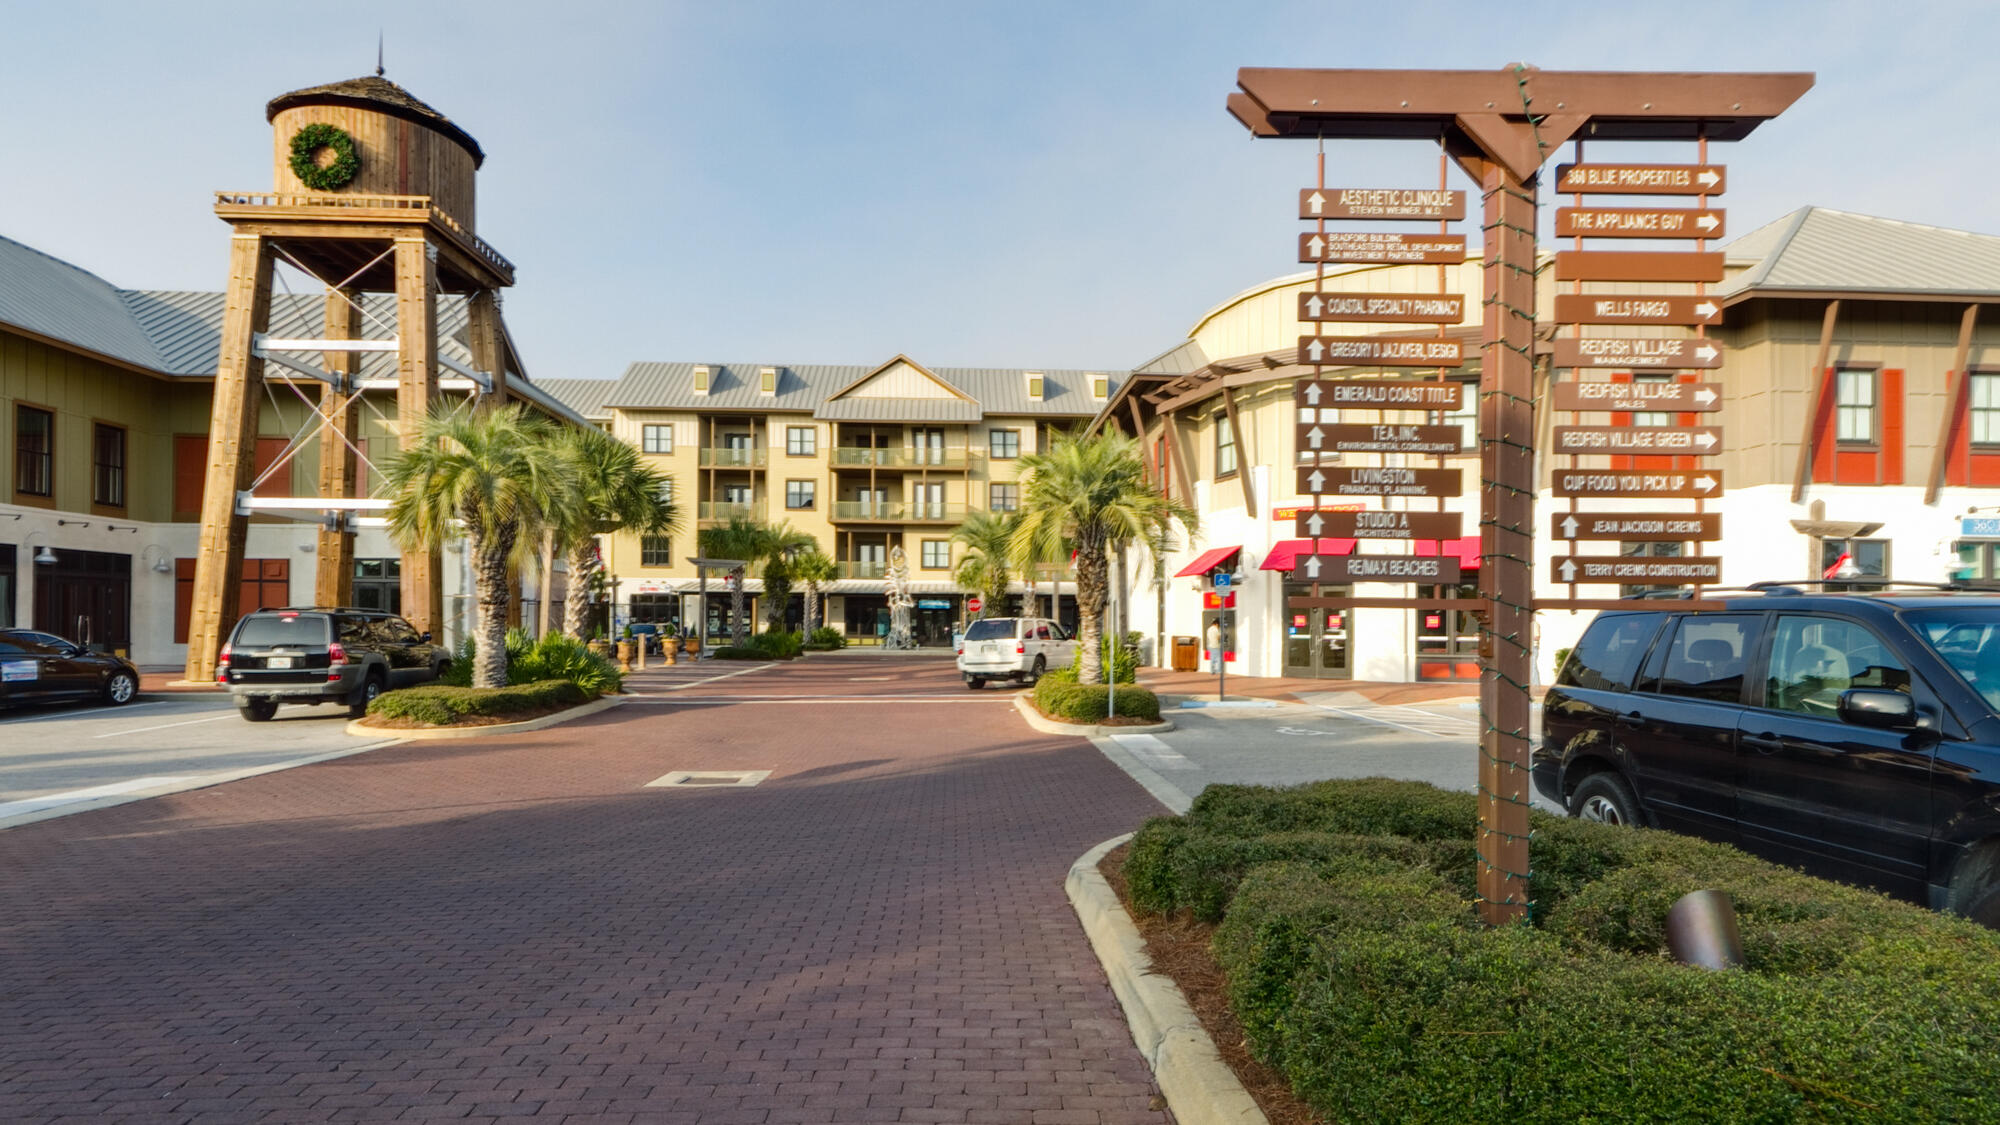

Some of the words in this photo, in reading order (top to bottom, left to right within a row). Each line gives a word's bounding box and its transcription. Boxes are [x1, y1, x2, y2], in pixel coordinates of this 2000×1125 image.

[1567, 170, 1585, 185] 360
[1588, 170, 1617, 185] BLUE
[1619, 170, 1691, 186] PROPERTIES
[1340, 190, 1400, 206] AESTHETIC
[1403, 191, 1453, 207] CLINIQUE
[1350, 207, 1384, 215] STEVEN
[1571, 213, 1593, 228] THE
[1595, 214, 1658, 230] APPLIANCE
[1661, 215, 1686, 230] GUY
[1411, 244, 1464, 252] DEVELOPMENT
[1344, 252, 1386, 260] INVESTMENT
[1388, 253, 1425, 261] PARTNERS
[1328, 298, 1367, 314] COASTAL
[1368, 299, 1413, 315] SPECIALTY
[1414, 300, 1462, 316] PHARMACY
[1595, 301, 1631, 316] WELLS
[1633, 302, 1670, 317] FARGO
[1331, 342, 1372, 358] GREGORY
[1428, 344, 1459, 359] DESIGN
[1579, 340, 1630, 356] REDFISH
[1632, 341, 1683, 356] VILLAGE
[1594, 357, 1669, 365] MANAGEMENT
[1334, 386, 1386, 402] EMERALD
[1388, 387, 1425, 403] COAST
[1427, 387, 1456, 403] TITLE
[1579, 384, 1630, 399] REDFISH
[1632, 384, 1683, 400] VILLAGE
[1614, 400, 1647, 408] SALES
[1337, 442, 1400, 451] ENVIRONMENTAL
[1401, 443, 1455, 452] CONSULTANTS
[1562, 432, 1607, 447] REDFISH
[1610, 432, 1654, 447] VILLAGE
[1656, 432, 1691, 448] GREEN
[1352, 469, 1416, 484] LIVINGSTON
[1564, 475, 1585, 491] CUP
[1587, 475, 1617, 491] FOOD
[1619, 475, 1641, 491] YOU
[1643, 476, 1669, 491] PICK
[1670, 476, 1686, 491] UP
[1339, 485, 1383, 494] FINANCIAL
[1384, 486, 1427, 495] PLANNING
[1356, 513, 1396, 528] STUDIO
[1400, 514, 1409, 528] A
[1592, 521, 1618, 533] JEAN
[1620, 521, 1664, 533] JACKSON
[1667, 521, 1702, 533] CREWS
[1353, 529, 1412, 538] ARCHITECTURE
[1390, 560, 1439, 576] BEACHES
[1584, 564, 1613, 576] TERRY
[1615, 564, 1647, 577] CREWS
[1649, 564, 1717, 577] CONSTRUCTION
